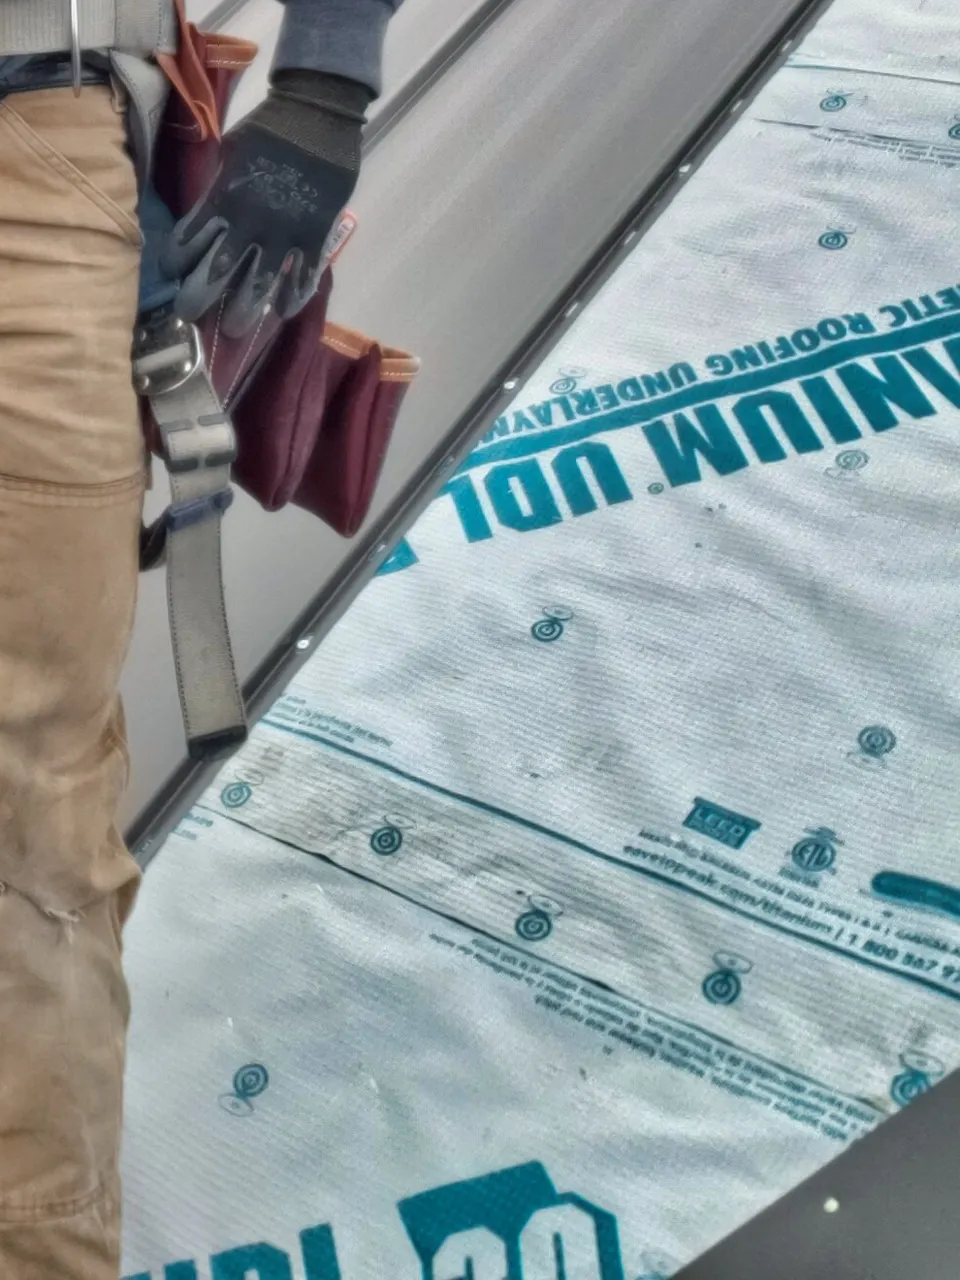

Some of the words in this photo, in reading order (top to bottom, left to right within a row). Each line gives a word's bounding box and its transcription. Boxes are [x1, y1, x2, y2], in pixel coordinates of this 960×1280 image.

[705, 308, 876, 376] ROOFING
[887, 284, 960, 329] ETIC
[480, 361, 698, 447] UNDERLAYM
[439, 441, 634, 543] UDL
